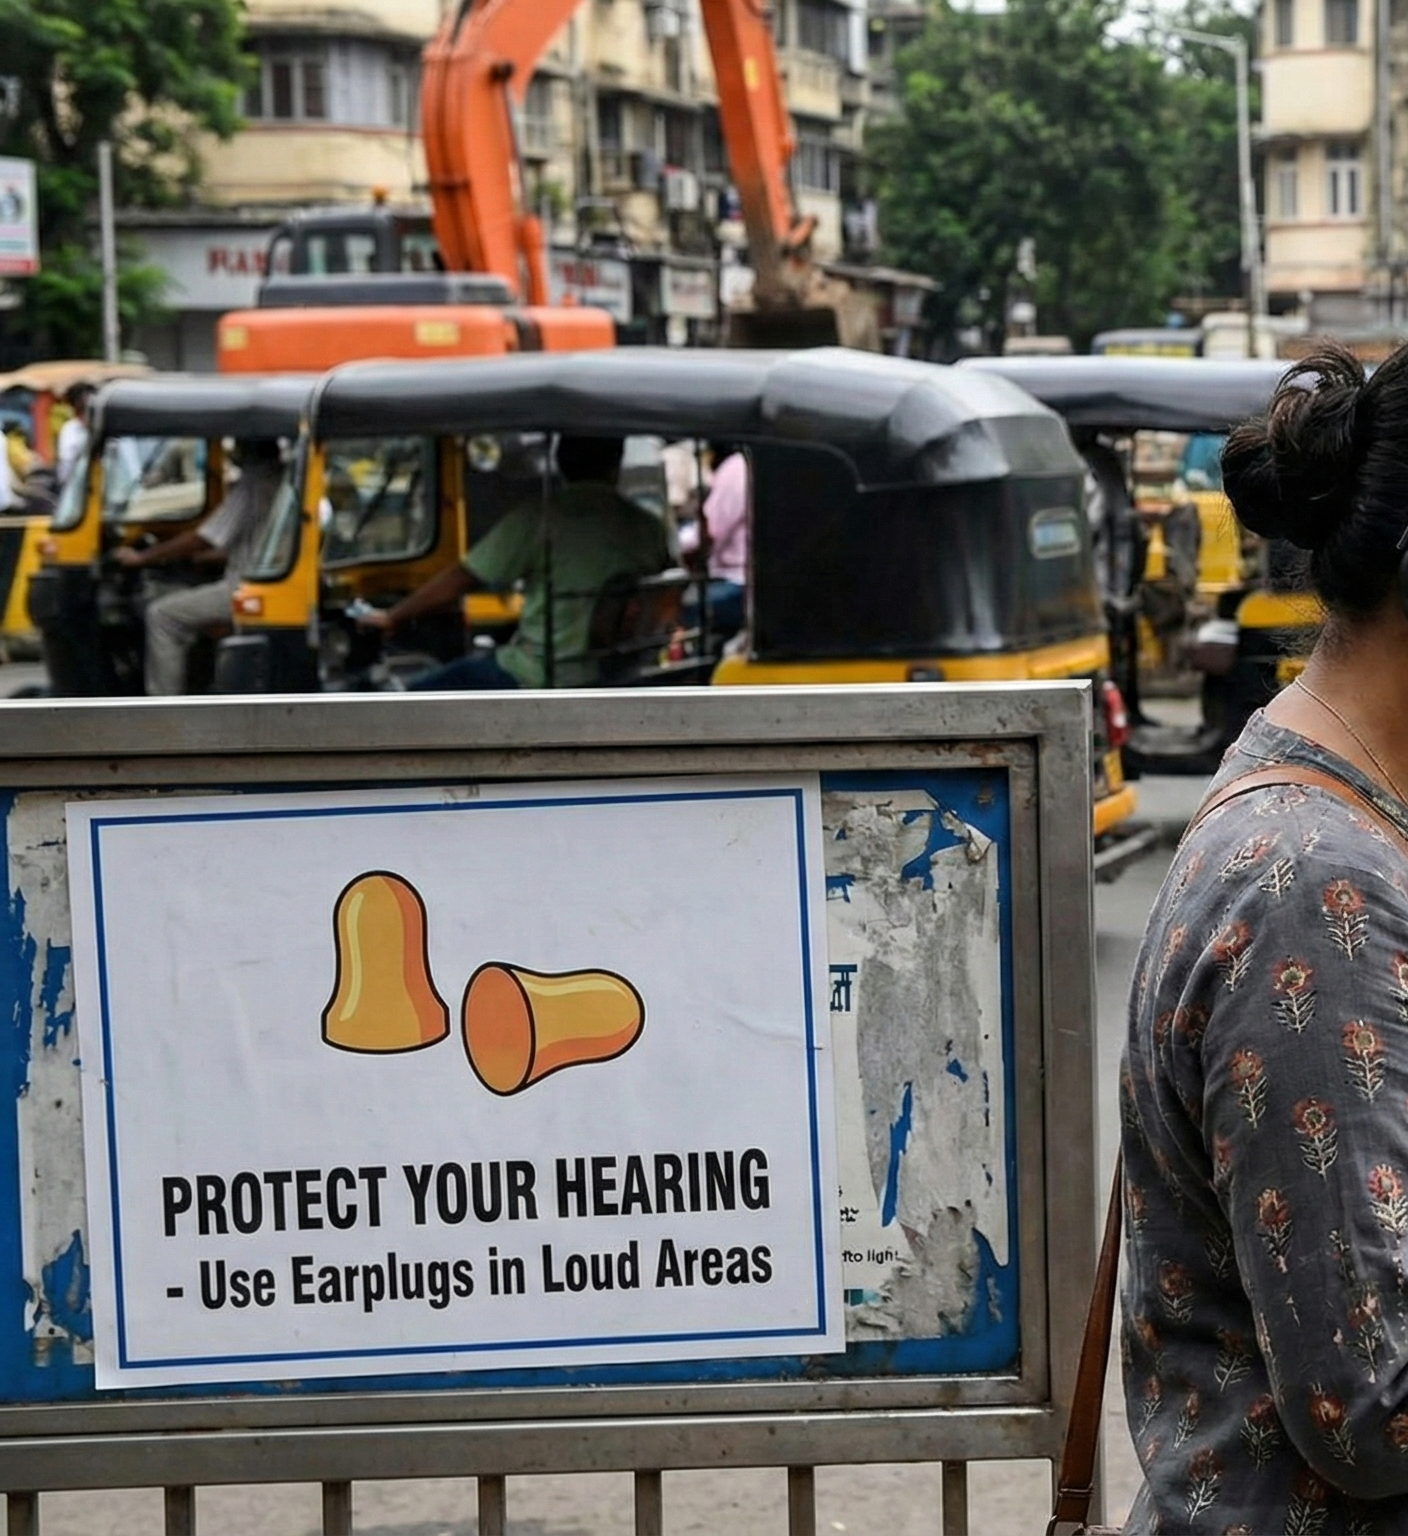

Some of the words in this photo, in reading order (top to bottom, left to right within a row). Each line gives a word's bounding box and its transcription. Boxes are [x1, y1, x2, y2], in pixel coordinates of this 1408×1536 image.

[162, 1166, 387, 1237] PROTECT
[401, 1160, 539, 1225] YOUR
[555, 1148, 770, 1218] HEARING
[199, 1259, 276, 1310] Use
[291, 1251, 474, 1313] Earplugs
[488, 1246, 526, 1296] in
[541, 1240, 640, 1293] Loud
[655, 1238, 773, 1288] Areas
